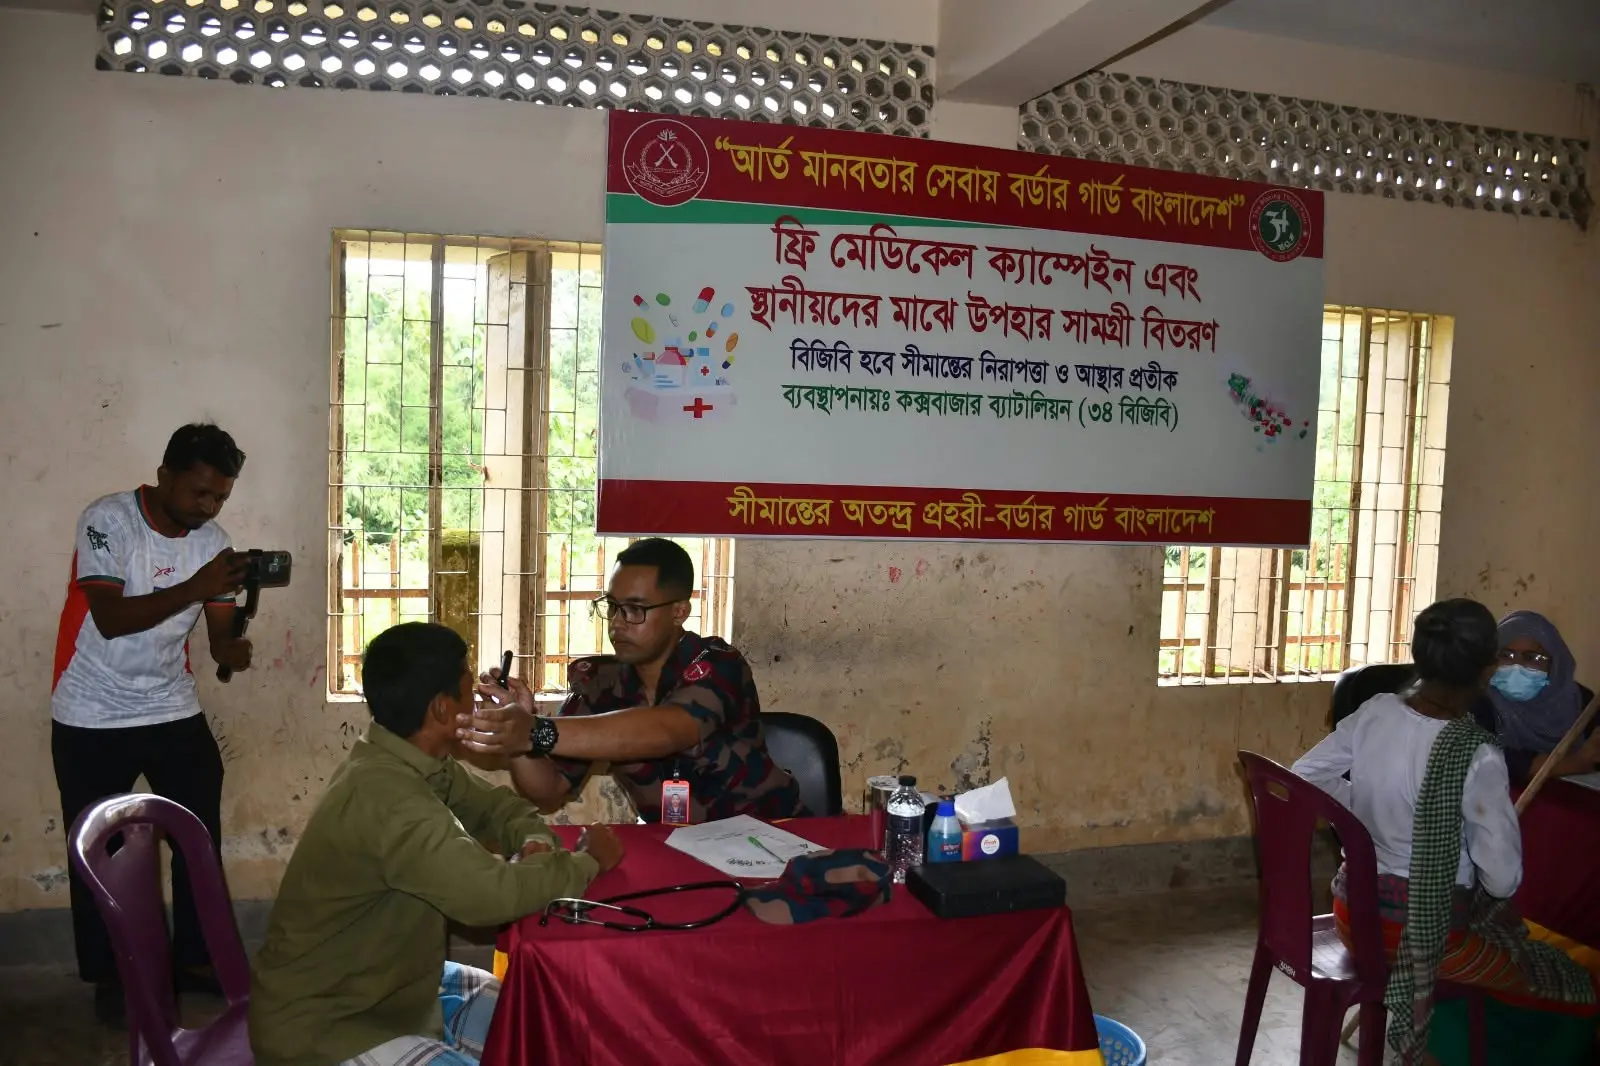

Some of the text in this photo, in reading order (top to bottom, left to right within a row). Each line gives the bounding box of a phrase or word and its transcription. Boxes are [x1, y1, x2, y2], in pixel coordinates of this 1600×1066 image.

[799, 149, 919, 195] মানবতার
[926, 164, 1001, 204] সেবায়
[1008, 164, 1071, 211] বর্ডার
[1078, 174, 1126, 216] গার্ড
[770, 214, 1201, 303] ফ্রি মেডিকেল ক্যাম্পেইন এবং
[744, 274, 1219, 353] স্থানীয়দের মাঝে উপহার সামগ্রী বিতরণ
[789, 338, 1178, 393] বিজিবি হবে সীমান্তের নিরাপত্তা ও আস্থার প্রতীক
[895, 390, 984, 416] কক্সবাজার
[987, 389, 1074, 421] ব্যাটালিয়ন
[726, 486, 834, 527] সীমান্তের
[840, 499, 916, 532] অতন্দ্র
[1063, 497, 1109, 532] গার্ড
[1114, 505, 1216, 536] বাংলাদেশ
